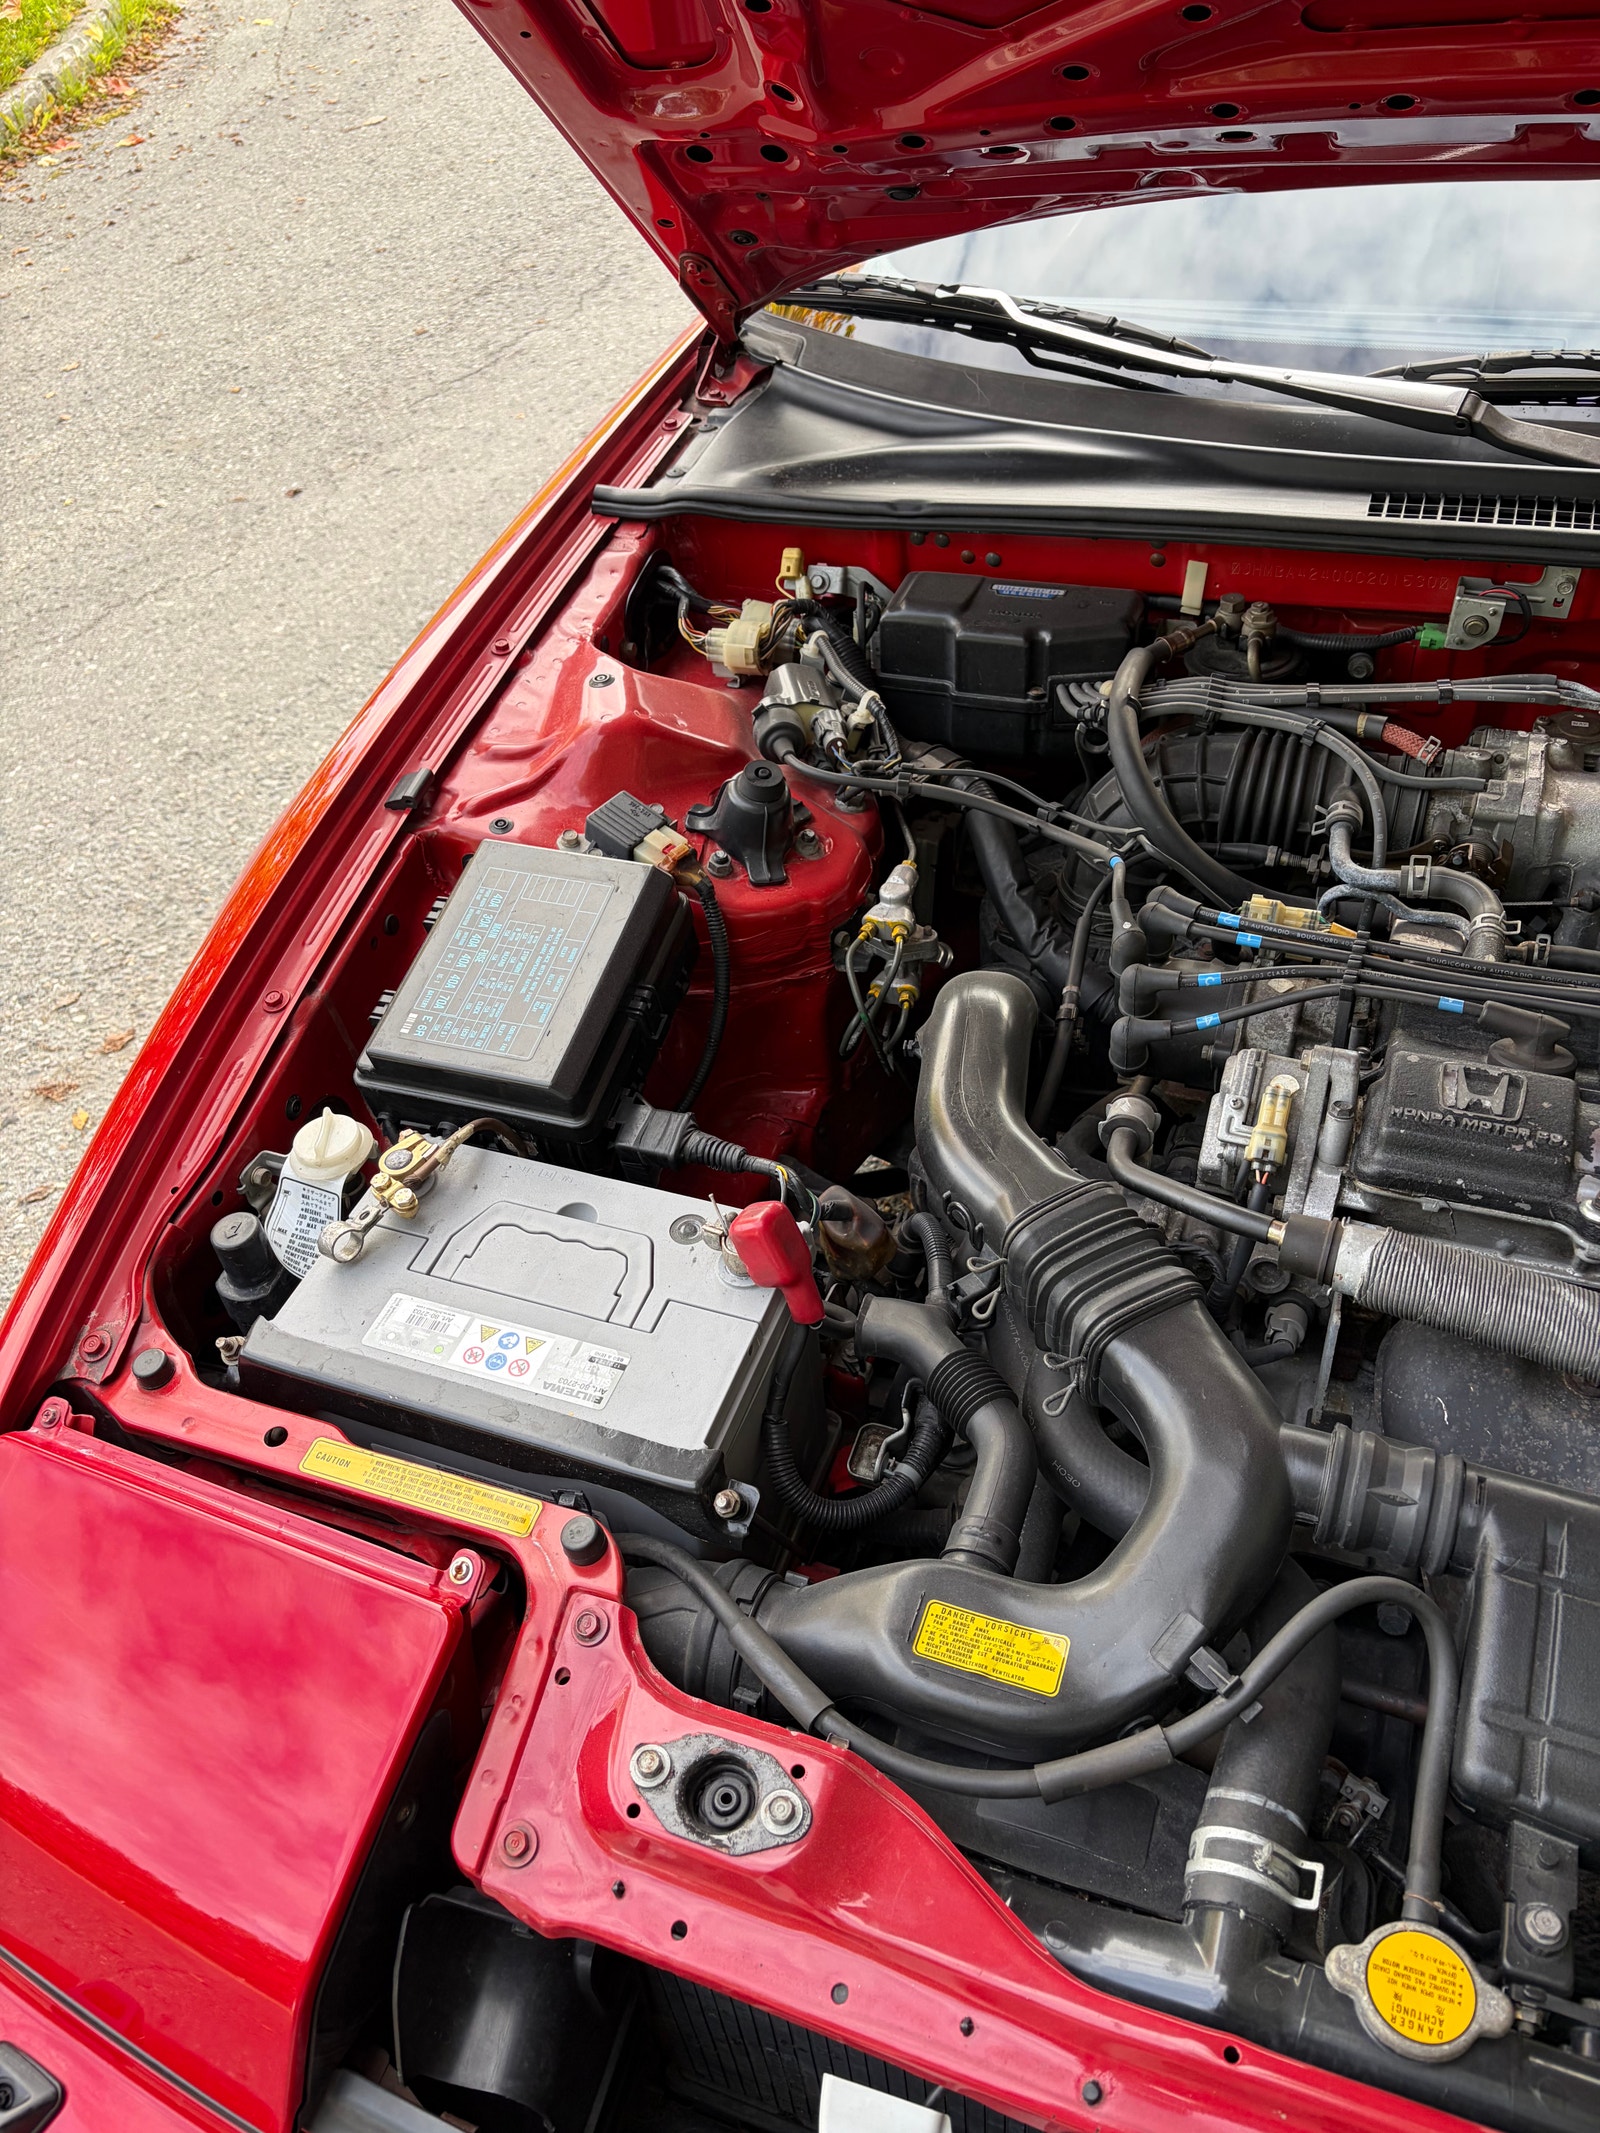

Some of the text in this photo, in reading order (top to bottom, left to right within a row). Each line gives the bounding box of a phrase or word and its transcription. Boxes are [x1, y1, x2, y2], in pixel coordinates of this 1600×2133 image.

[487, 893, 503, 907] 40A
[477, 913, 493, 928] 30A
[466, 933, 483, 947] 40A
[1250, 923, 1290, 935] AUTORADIO
[1296, 932, 1339, 945] BOUGICORD
[455, 953, 472, 967] 40A
[474, 948, 489, 963] FUSE
[1426, 956, 1470, 969] BOUGICORD
[1489, 968, 1534, 979] AUTORADIO
[444, 974, 461, 988] 40A
[433, 994, 449, 1009] 70A
[1391, 1105, 1456, 1128] HONDA
[1460, 1118, 1531, 1140] MOTOR
[304, 1208, 321, 1217] RESERVE
[309, 1216, 327, 1225] COOLANT
[278, 1227, 288, 1235] MAX
[285, 1250, 308, 1262] REMETTRE
[411, 1307, 440, 1319] 80-2703
[541, 1380, 603, 1405] BILTEMA
[557, 1375, 607, 1396] Art. 80-2703
[314, 1450, 351, 1468] CAUTION
[940, 1607, 976, 1623] DANGER
[984, 1620, 1032, 1640] VORSICHT
[947, 1624, 968, 1634] STARTS
[951, 1619, 970, 1628] HANDS
[925, 1641, 942, 1650] NICHT
[938, 1639, 973, 1654] VENTILATEUR
[951, 1637, 980, 1650] APPROCHER
[996, 1650, 1013, 1659] MAINS
[1382, 1958, 1400, 1969] MOTOR
[1403, 1965, 1426, 1976] HEISSEM
[1394, 1971, 1411, 1981] QUAND
[1415, 1978, 1426, 1986] PAS
[1441, 1979, 1456, 1987] NICHT
[1402, 1983, 1417, 1992] WHEN
[1421, 1989, 1434, 1998] OPEN
[1438, 1994, 1455, 2005] NEVER
[1392, 2002, 1444, 2027] ACHTUNG!
[1391, 2013, 1444, 2040] DANGER
